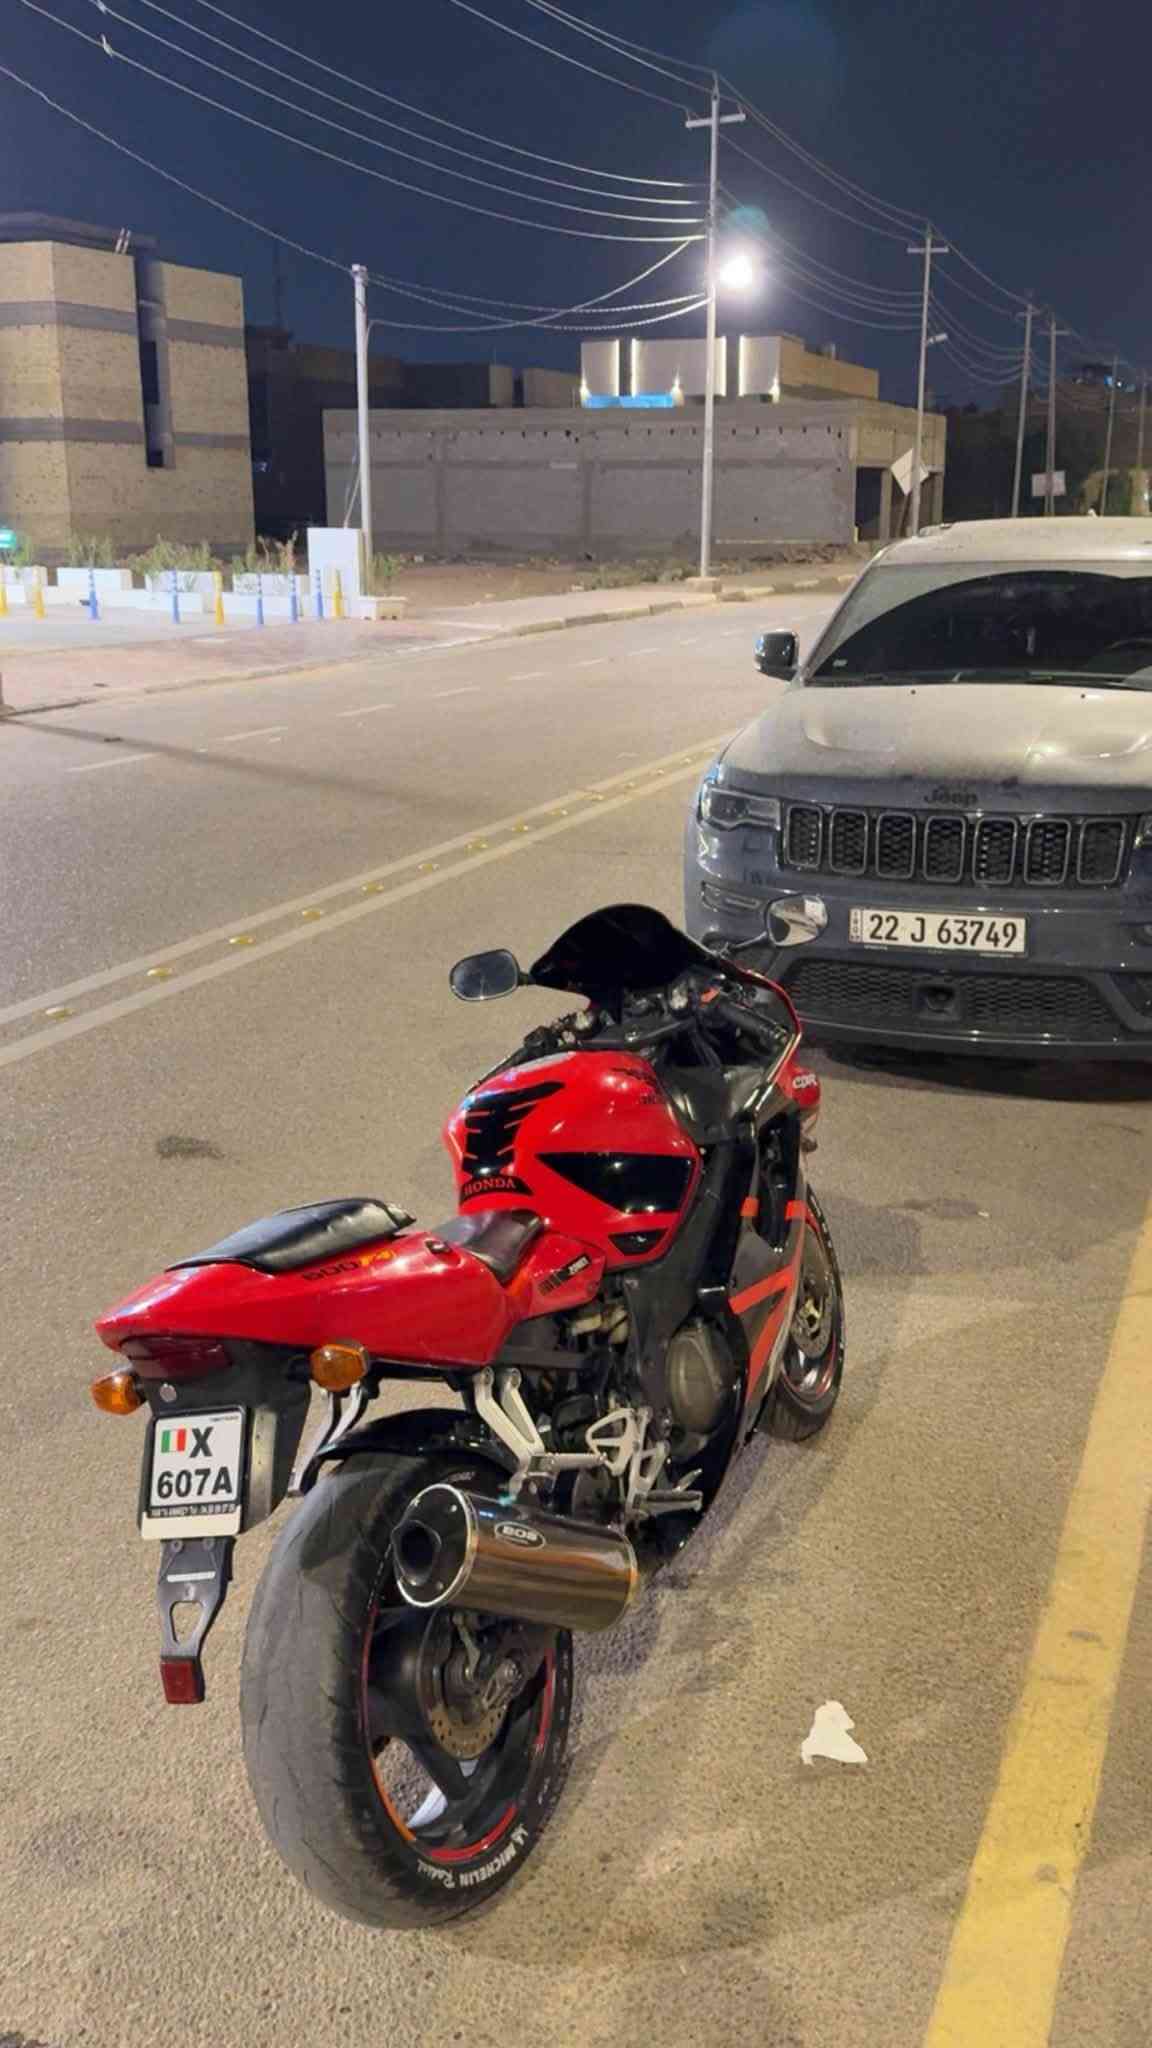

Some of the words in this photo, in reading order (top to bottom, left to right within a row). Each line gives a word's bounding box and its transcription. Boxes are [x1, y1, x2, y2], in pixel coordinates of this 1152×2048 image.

[869, 914, 899, 941] 22
[911, 917, 926, 943] J
[937, 918, 1017, 948] 63749
[464, 1177, 516, 1196] HONDA
[189, 1426, 214, 1458] X
[157, 1466, 233, 1499] 607A
